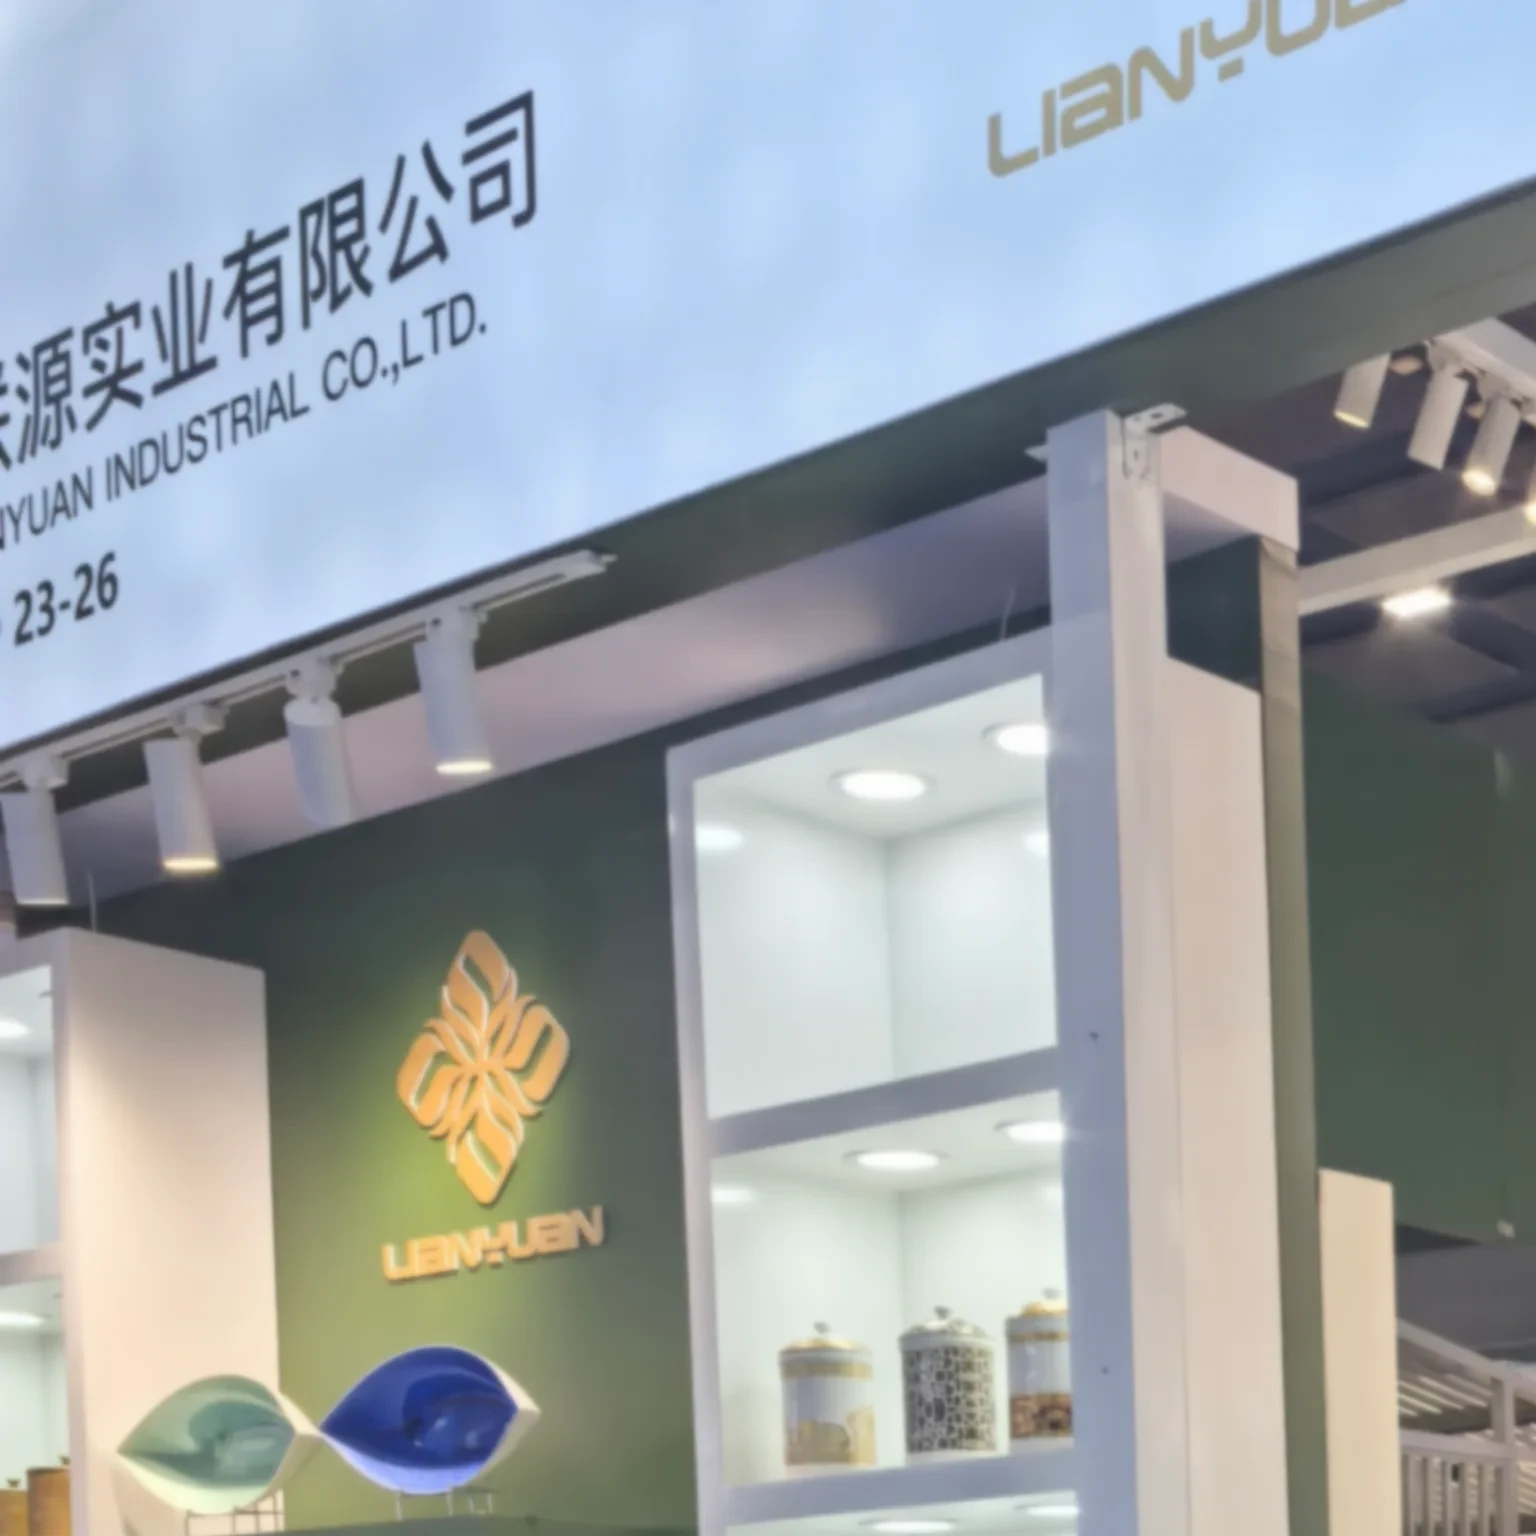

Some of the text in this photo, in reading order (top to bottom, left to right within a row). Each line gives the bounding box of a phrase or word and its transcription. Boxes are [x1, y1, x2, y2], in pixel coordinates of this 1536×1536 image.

[0, 292, 487, 550] YUAN INDUSTRIAL CO.,LTD.
[13, 551, 119, 647] 23-26
